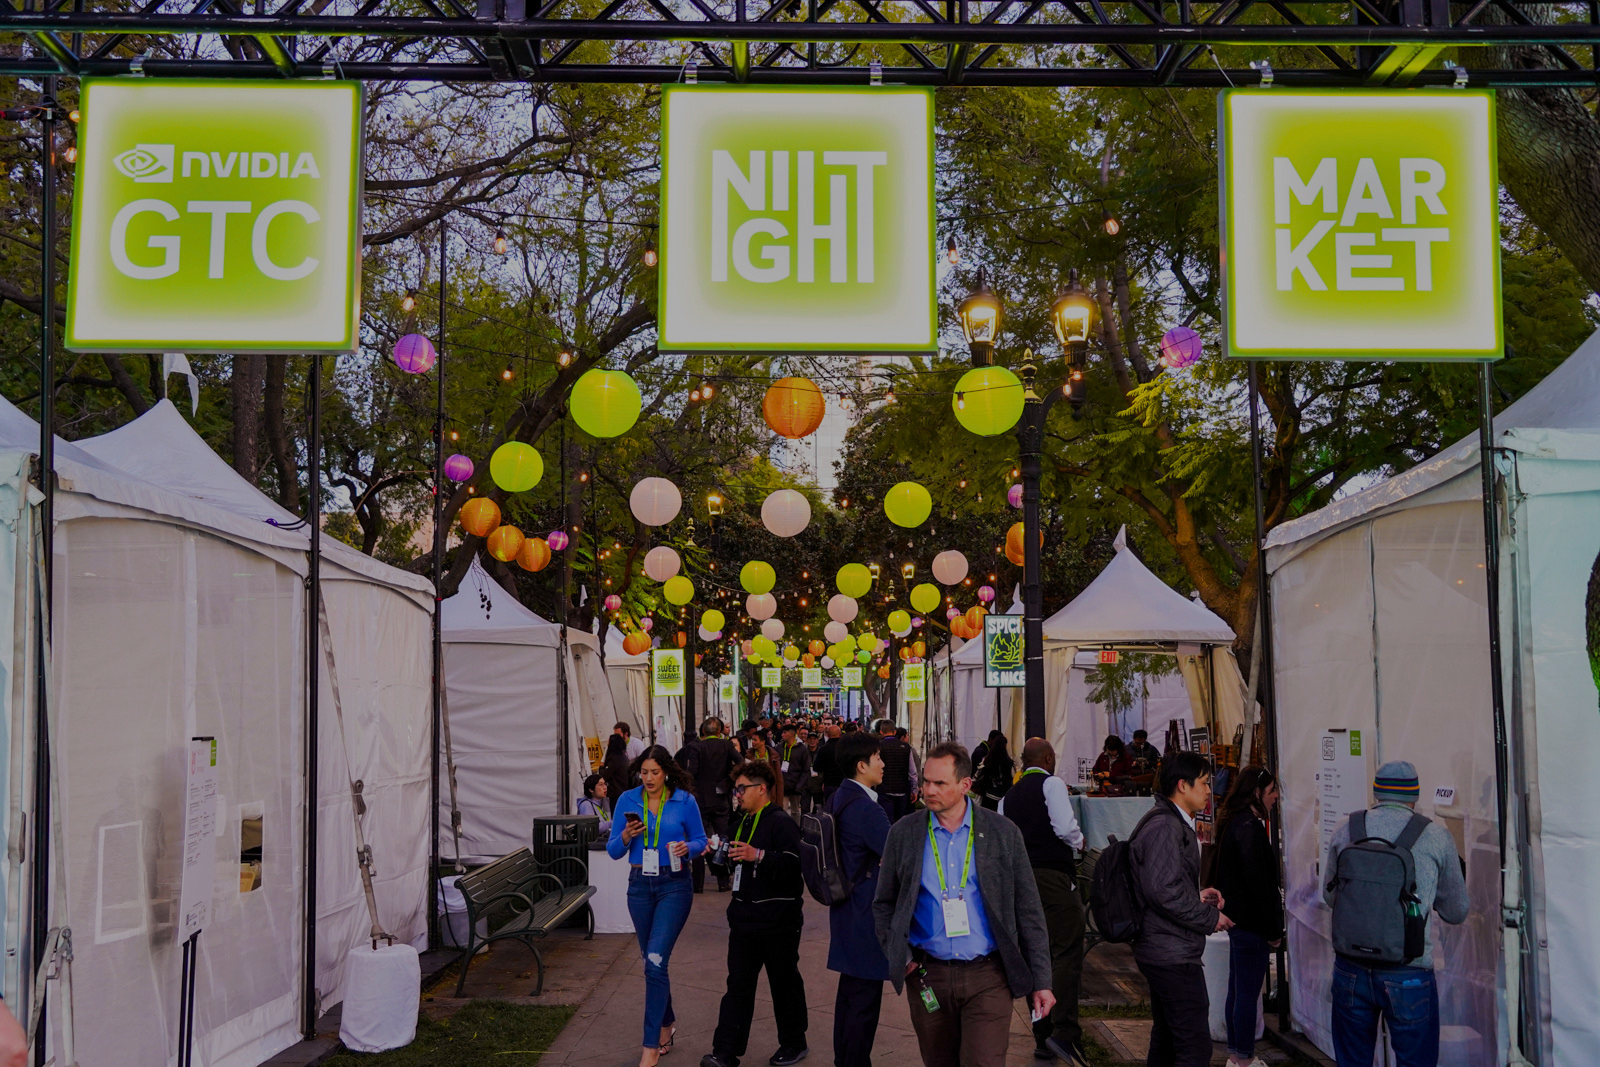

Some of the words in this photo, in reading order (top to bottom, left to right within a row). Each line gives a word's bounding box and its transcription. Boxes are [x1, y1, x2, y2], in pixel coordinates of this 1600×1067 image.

[109, 198, 321, 281] GTC
[1101, 651, 1117, 663] EXIT
[657, 664, 680, 673] SWEET
[988, 670, 999, 686] IS
[1001, 670, 1026, 686] NICE
[1435, 788, 1453, 798] PICKUP
